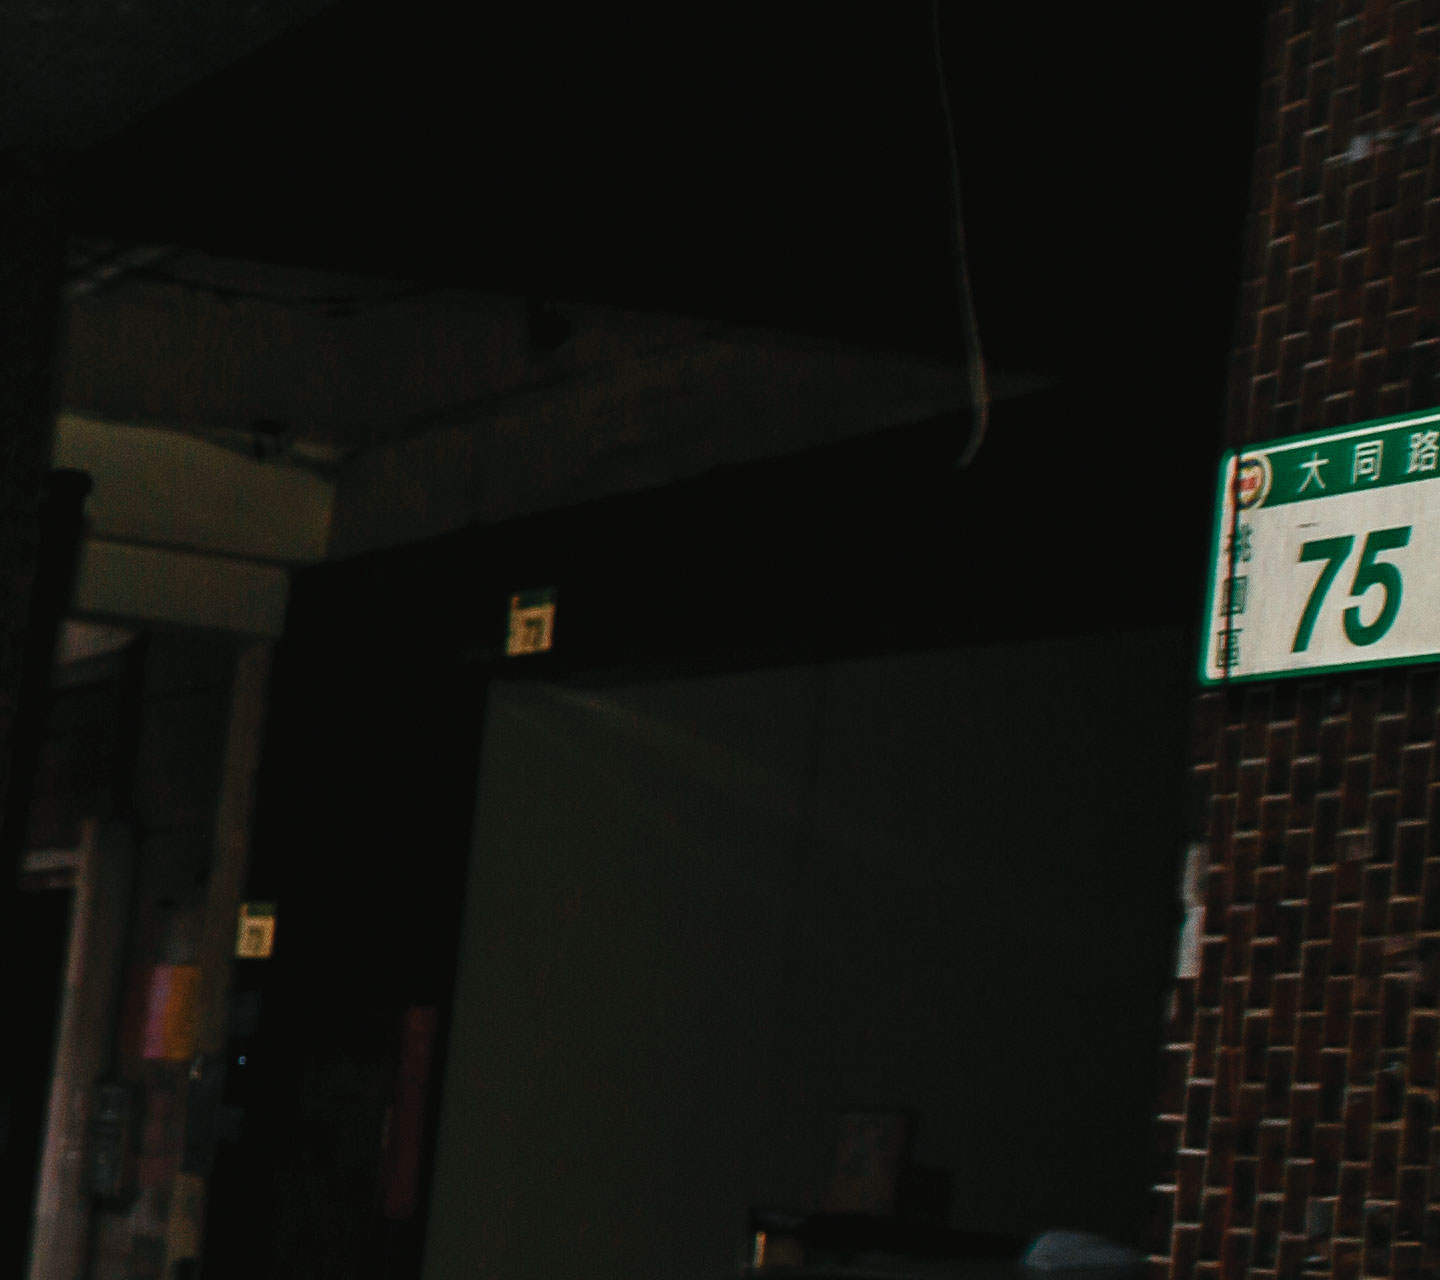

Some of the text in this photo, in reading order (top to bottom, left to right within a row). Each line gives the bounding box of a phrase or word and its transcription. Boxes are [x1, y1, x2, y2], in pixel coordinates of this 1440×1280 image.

[1298, 430, 1440, 492] 大同路
[1290, 525, 1413, 653] 75
